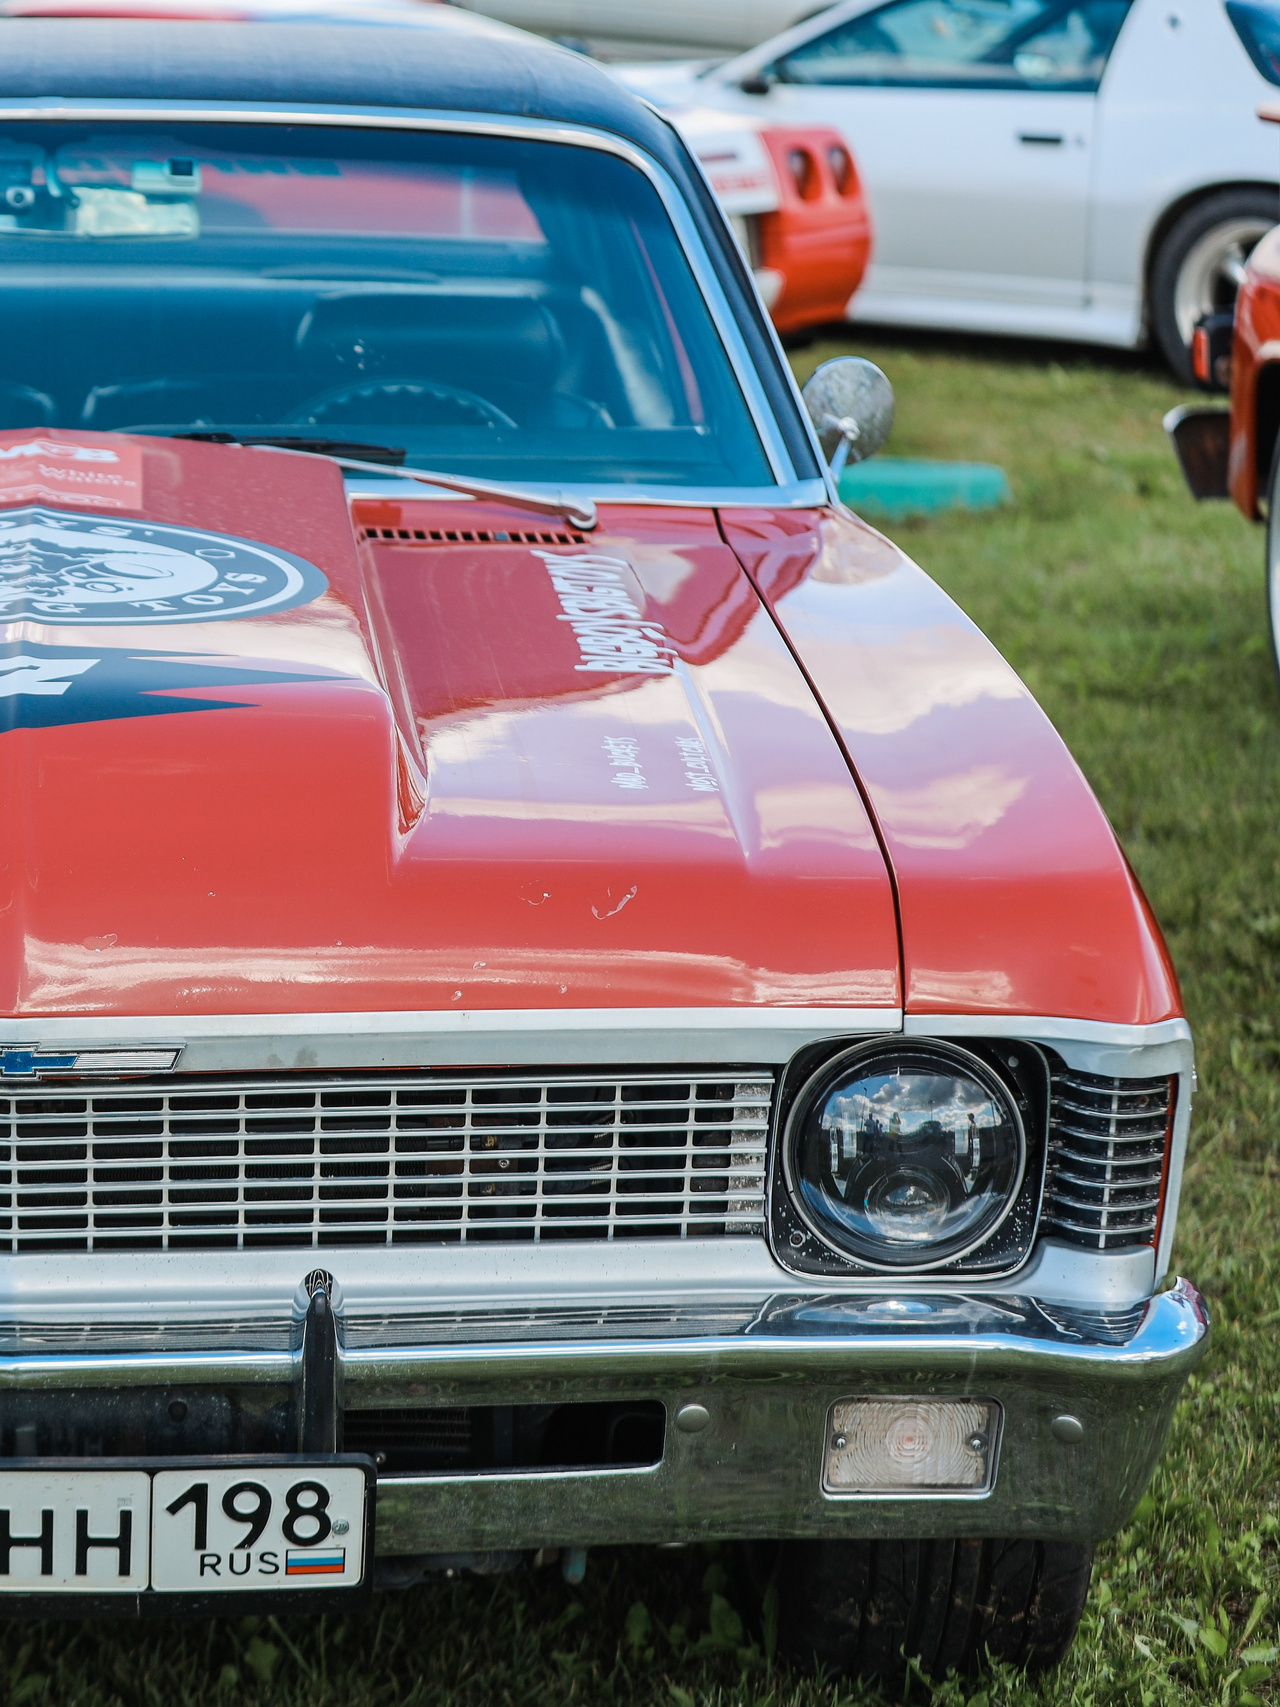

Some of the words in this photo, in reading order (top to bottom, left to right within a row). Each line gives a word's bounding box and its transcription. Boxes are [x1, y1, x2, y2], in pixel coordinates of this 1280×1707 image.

[131, 571, 268, 612] TOYS
[165, 1481, 332, 1550] 198
[199, 1552, 280, 1576] RUS
